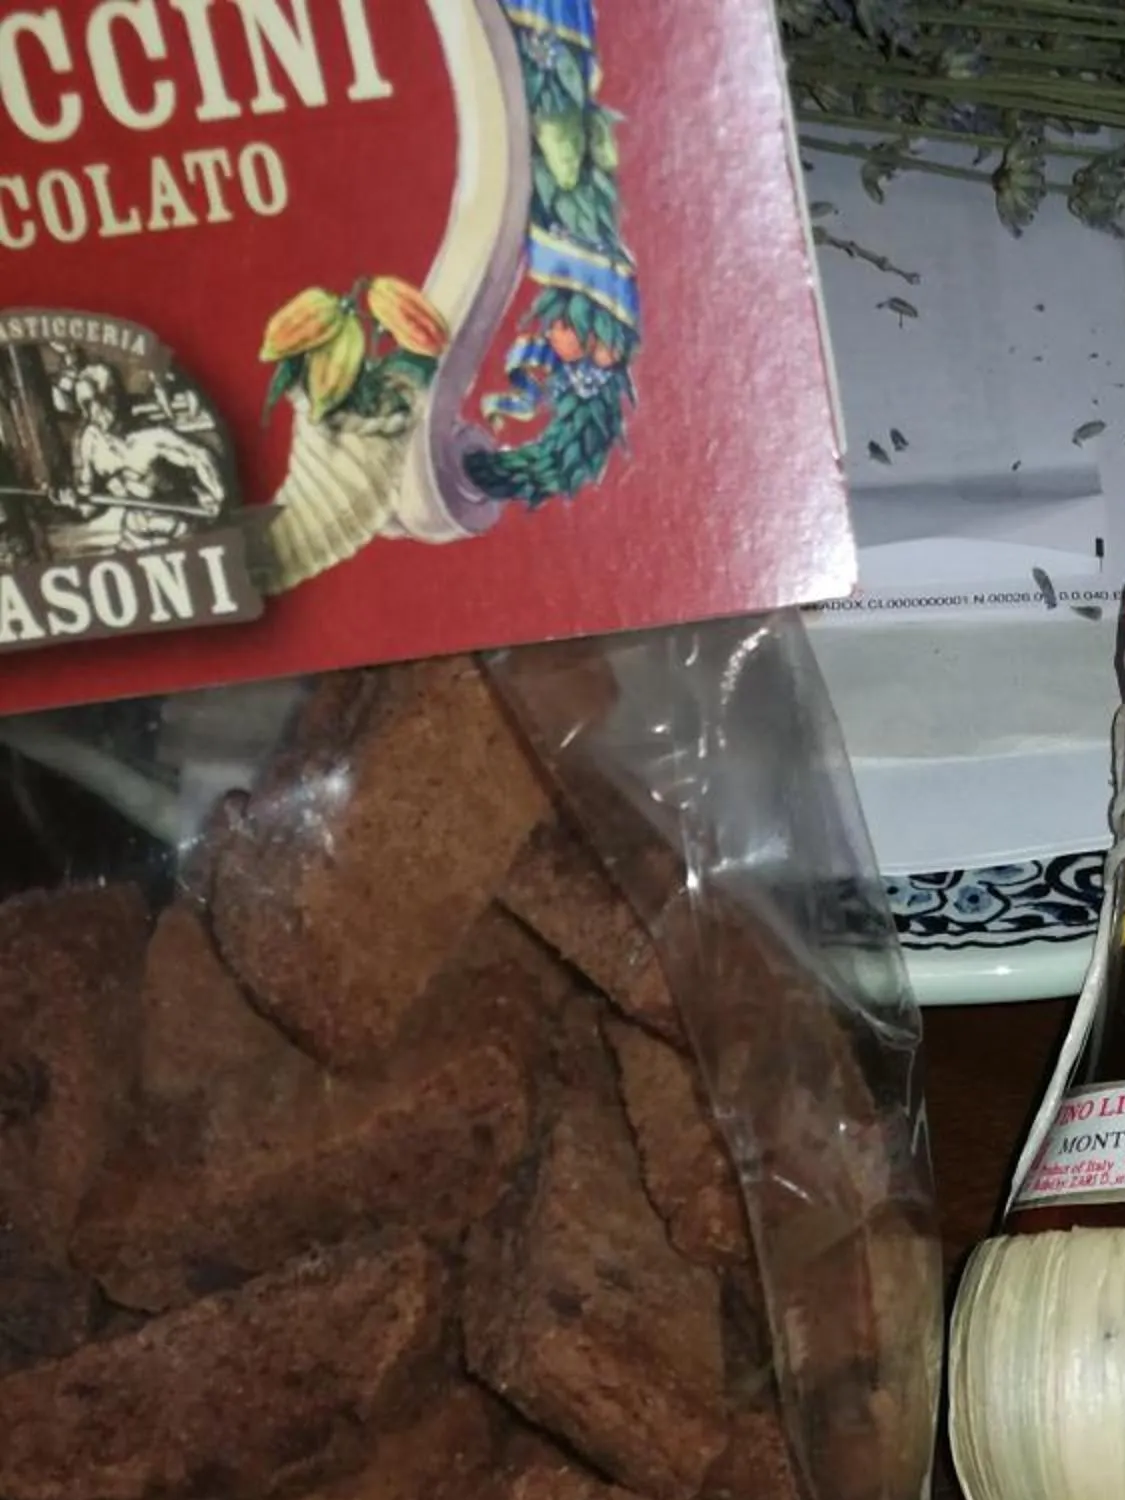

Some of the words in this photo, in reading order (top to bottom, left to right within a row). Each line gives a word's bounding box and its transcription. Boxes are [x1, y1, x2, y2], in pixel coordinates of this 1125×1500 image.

[0, 0, 394, 143] CCINI
[0, 142, 289, 250] COLATO
[0, 545, 239, 643] ASONI
